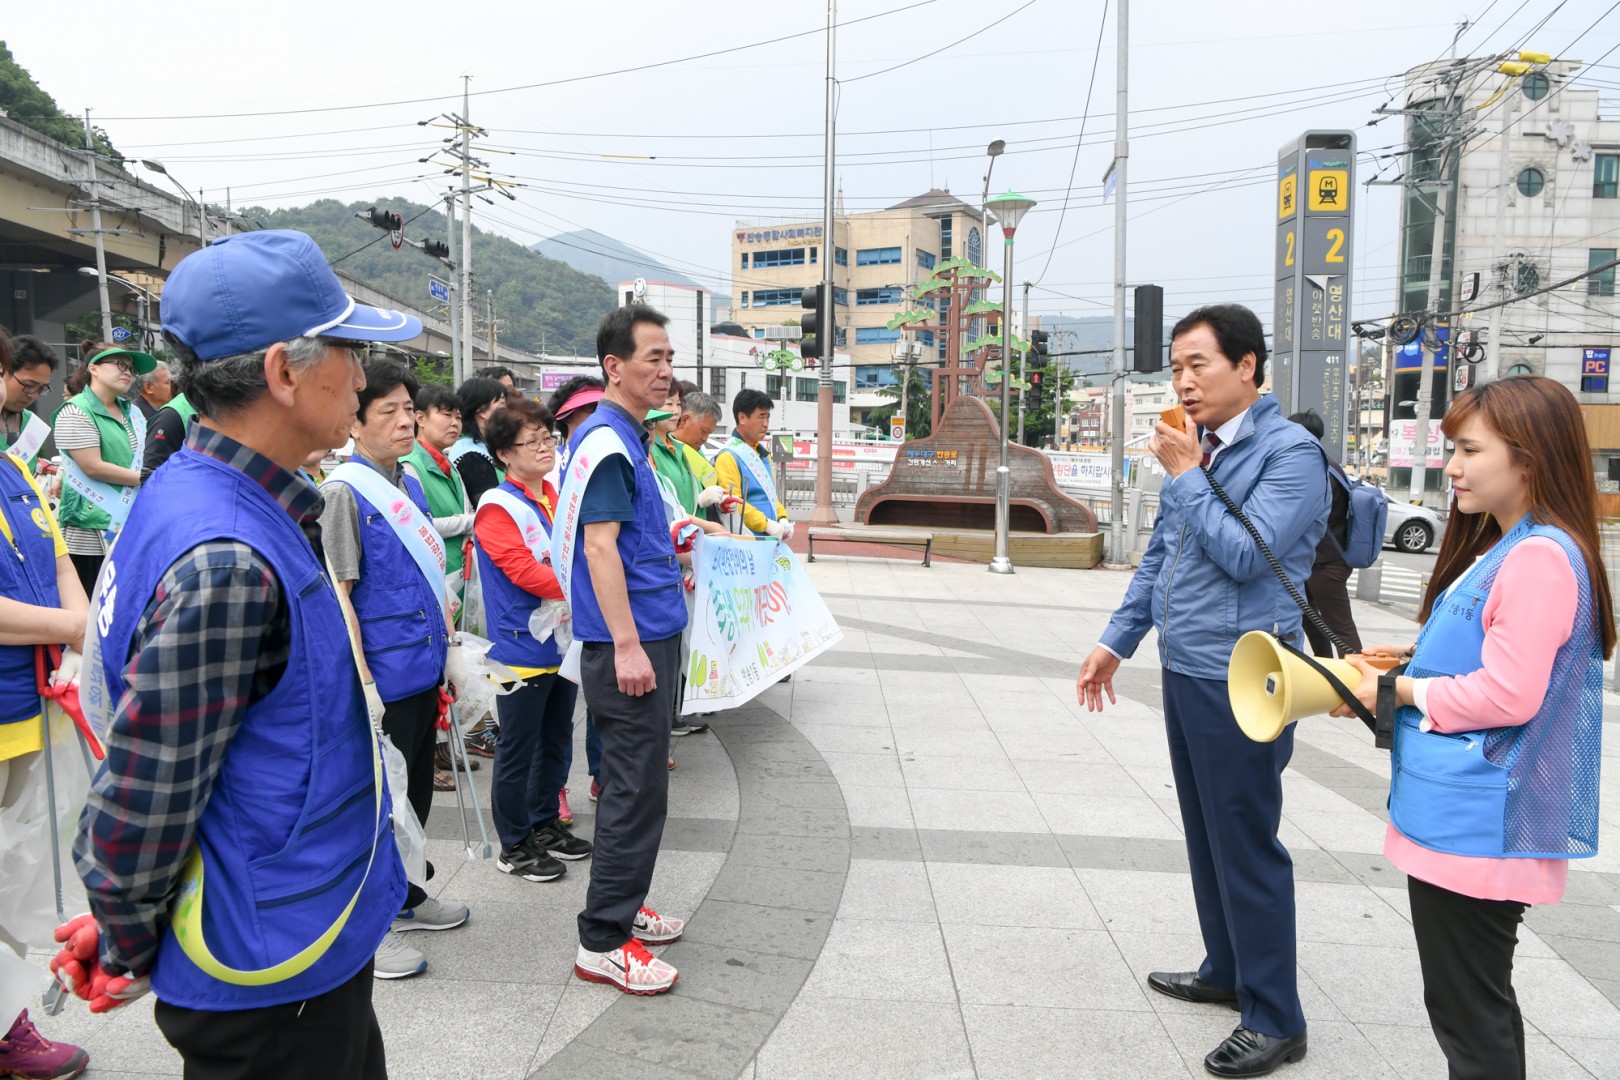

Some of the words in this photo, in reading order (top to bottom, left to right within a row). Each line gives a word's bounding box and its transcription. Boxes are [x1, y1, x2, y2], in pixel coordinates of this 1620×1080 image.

[1285, 231, 1295, 267] 2
[1325, 228, 1344, 263] 2
[1311, 290, 1323, 341] 아랫반송
[1327, 285, 1343, 341] 영산대
[113, 330, 126, 338] 827
[1326, 355, 1340, 364] 411
[1585, 360, 1606, 373] PC
[1053, 464, 1079, 477] 횡단을
[1080, 465, 1112, 478] 하지맙시
